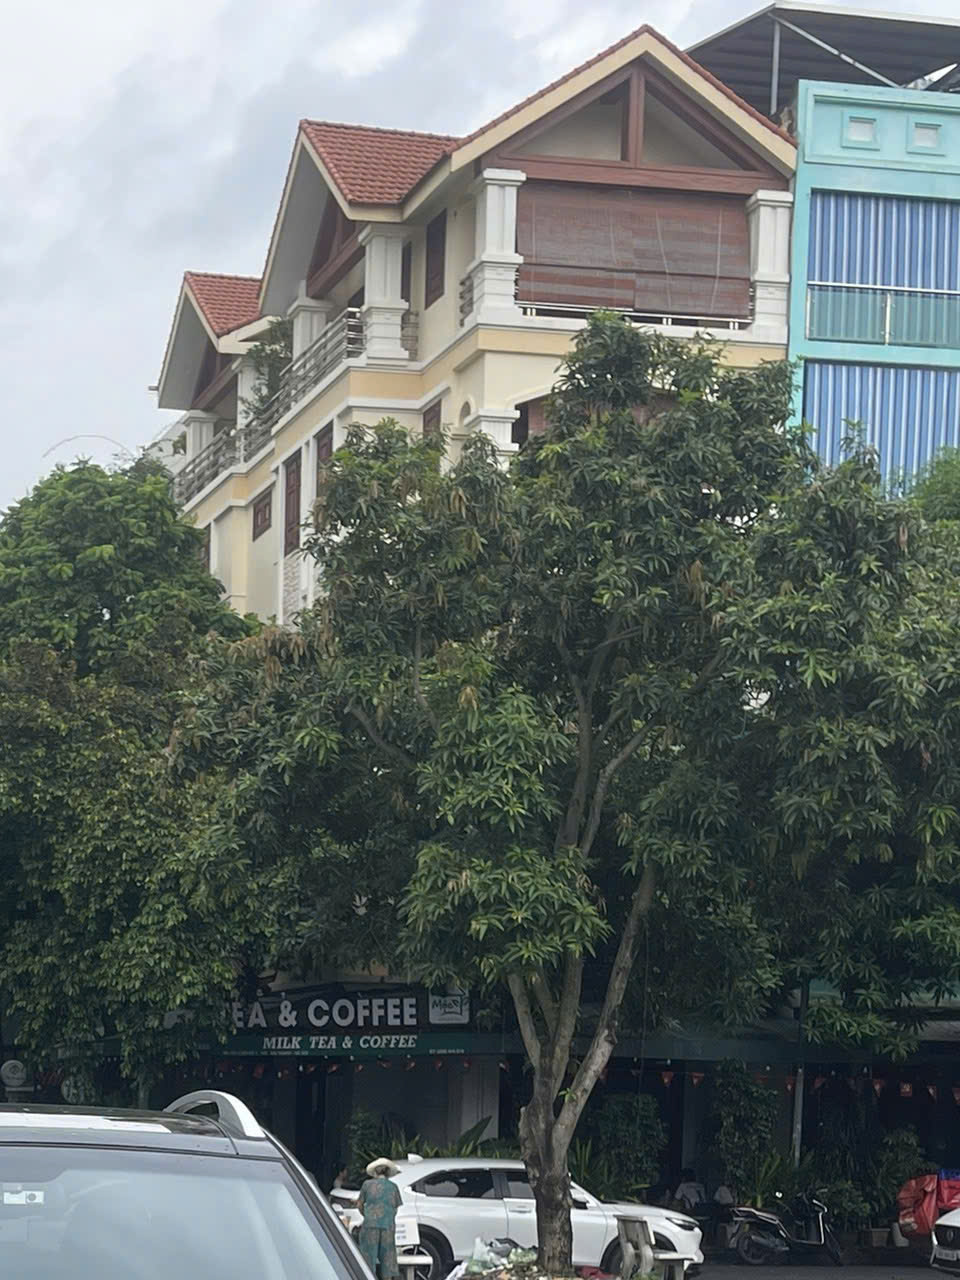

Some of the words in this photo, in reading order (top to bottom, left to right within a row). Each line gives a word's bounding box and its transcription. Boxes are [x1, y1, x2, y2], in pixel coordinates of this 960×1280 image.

[230, 1000, 267, 1028] EA
[278, 1000, 298, 1028] &
[307, 998, 417, 1027] COFFEE
[263, 1036, 302, 1049] MILK
[309, 1036, 337, 1049] TEA
[342, 1036, 353, 1049] &
[359, 1035, 418, 1048] COFFEE
